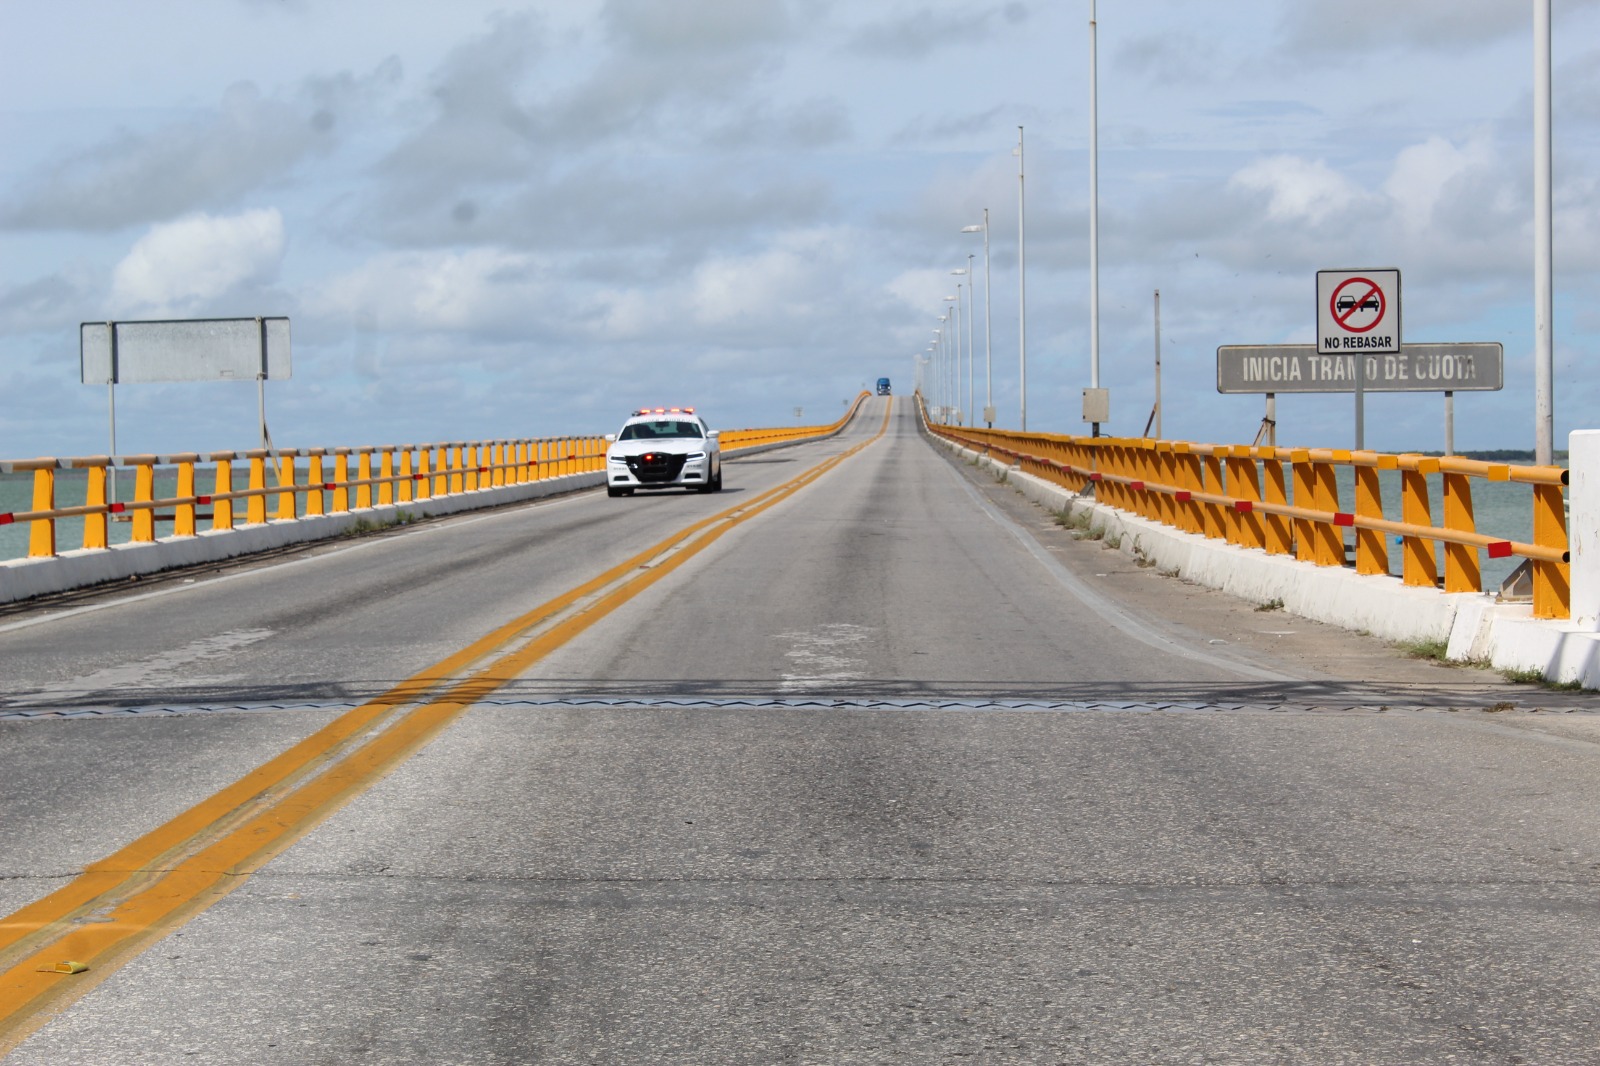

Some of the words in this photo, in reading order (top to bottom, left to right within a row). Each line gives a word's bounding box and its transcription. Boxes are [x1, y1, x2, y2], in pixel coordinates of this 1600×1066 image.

[1324, 336, 1340, 349] NO
[1343, 335, 1392, 349] REBASAR
[1243, 356, 1302, 381] INICIA
[1384, 355, 1409, 380] DE
[1415, 354, 1476, 380] CUOTA
